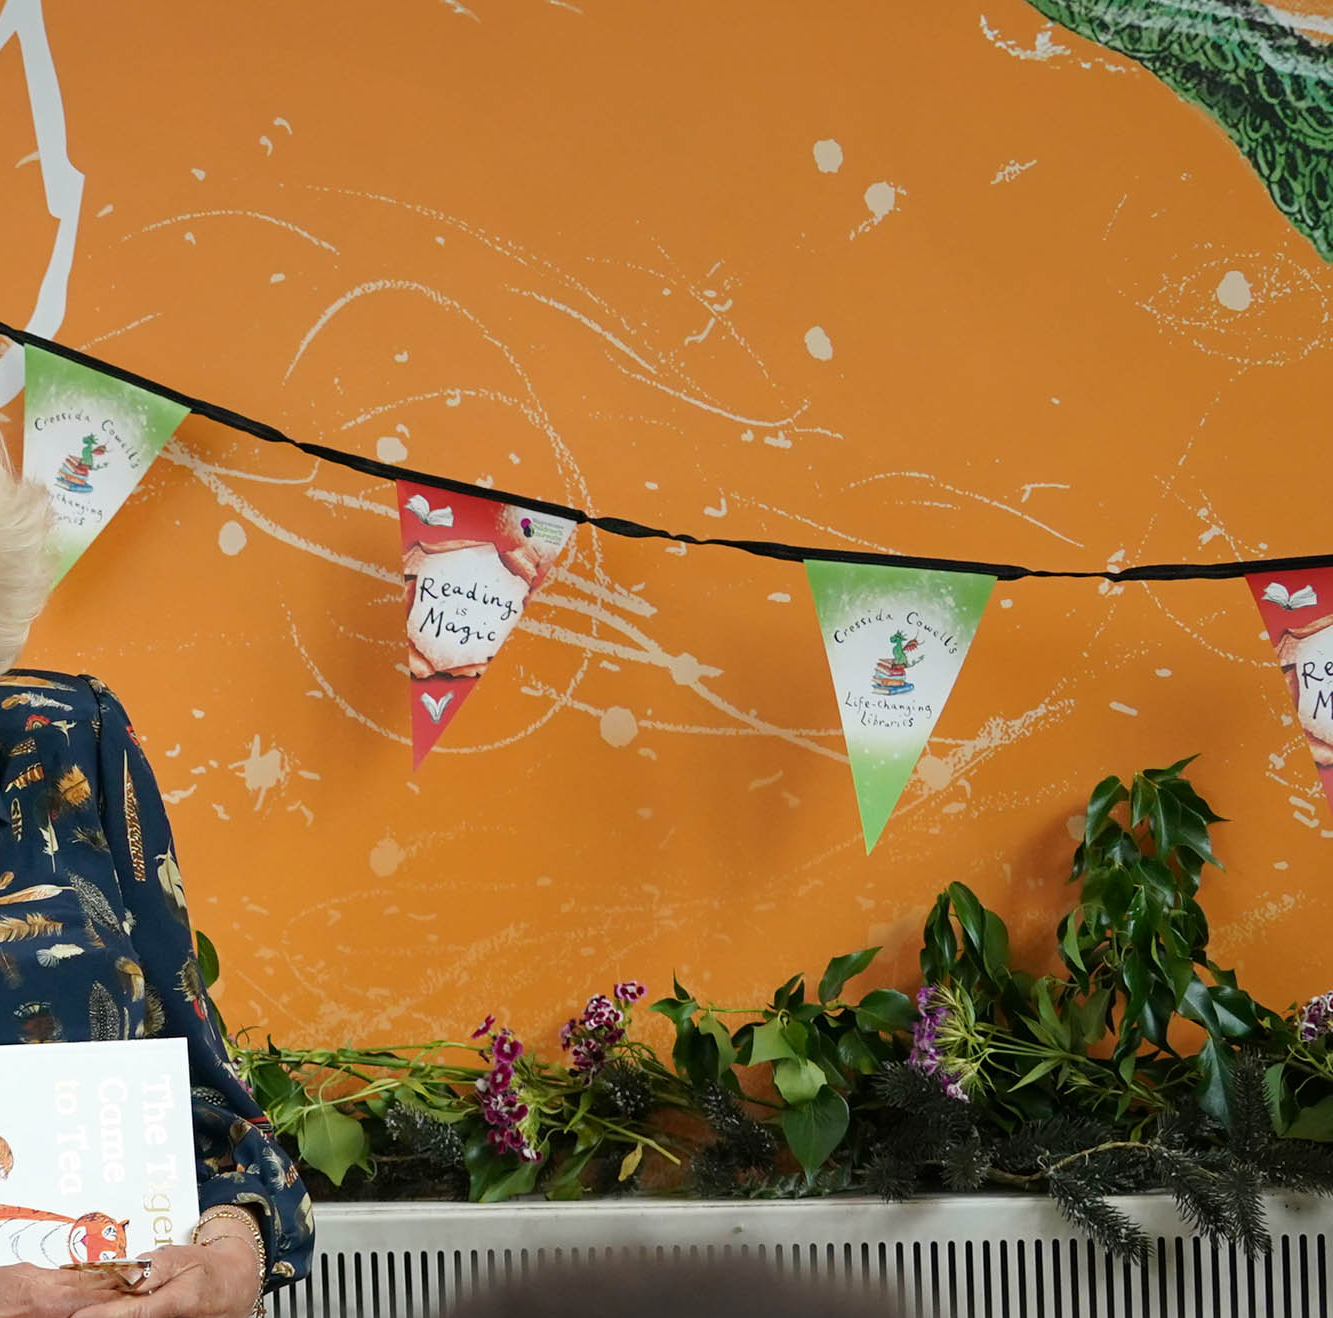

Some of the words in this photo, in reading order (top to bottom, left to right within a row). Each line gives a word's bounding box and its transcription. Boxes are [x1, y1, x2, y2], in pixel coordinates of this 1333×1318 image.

[419, 577, 518, 620] Reading
[455, 606, 468, 617] is
[419, 607, 496, 645] Magic
[833, 608, 894, 644] Cressida
[906, 610, 958, 655] Cowell's
[860, 711, 915, 728] Libraries
[54, 1079, 81, 1116] to
[141, 1073, 175, 1145] The
[98, 1076, 128, 1184] Came
[56, 1124, 90, 1197] Tea
[143, 1153, 178, 1245] Tiger
